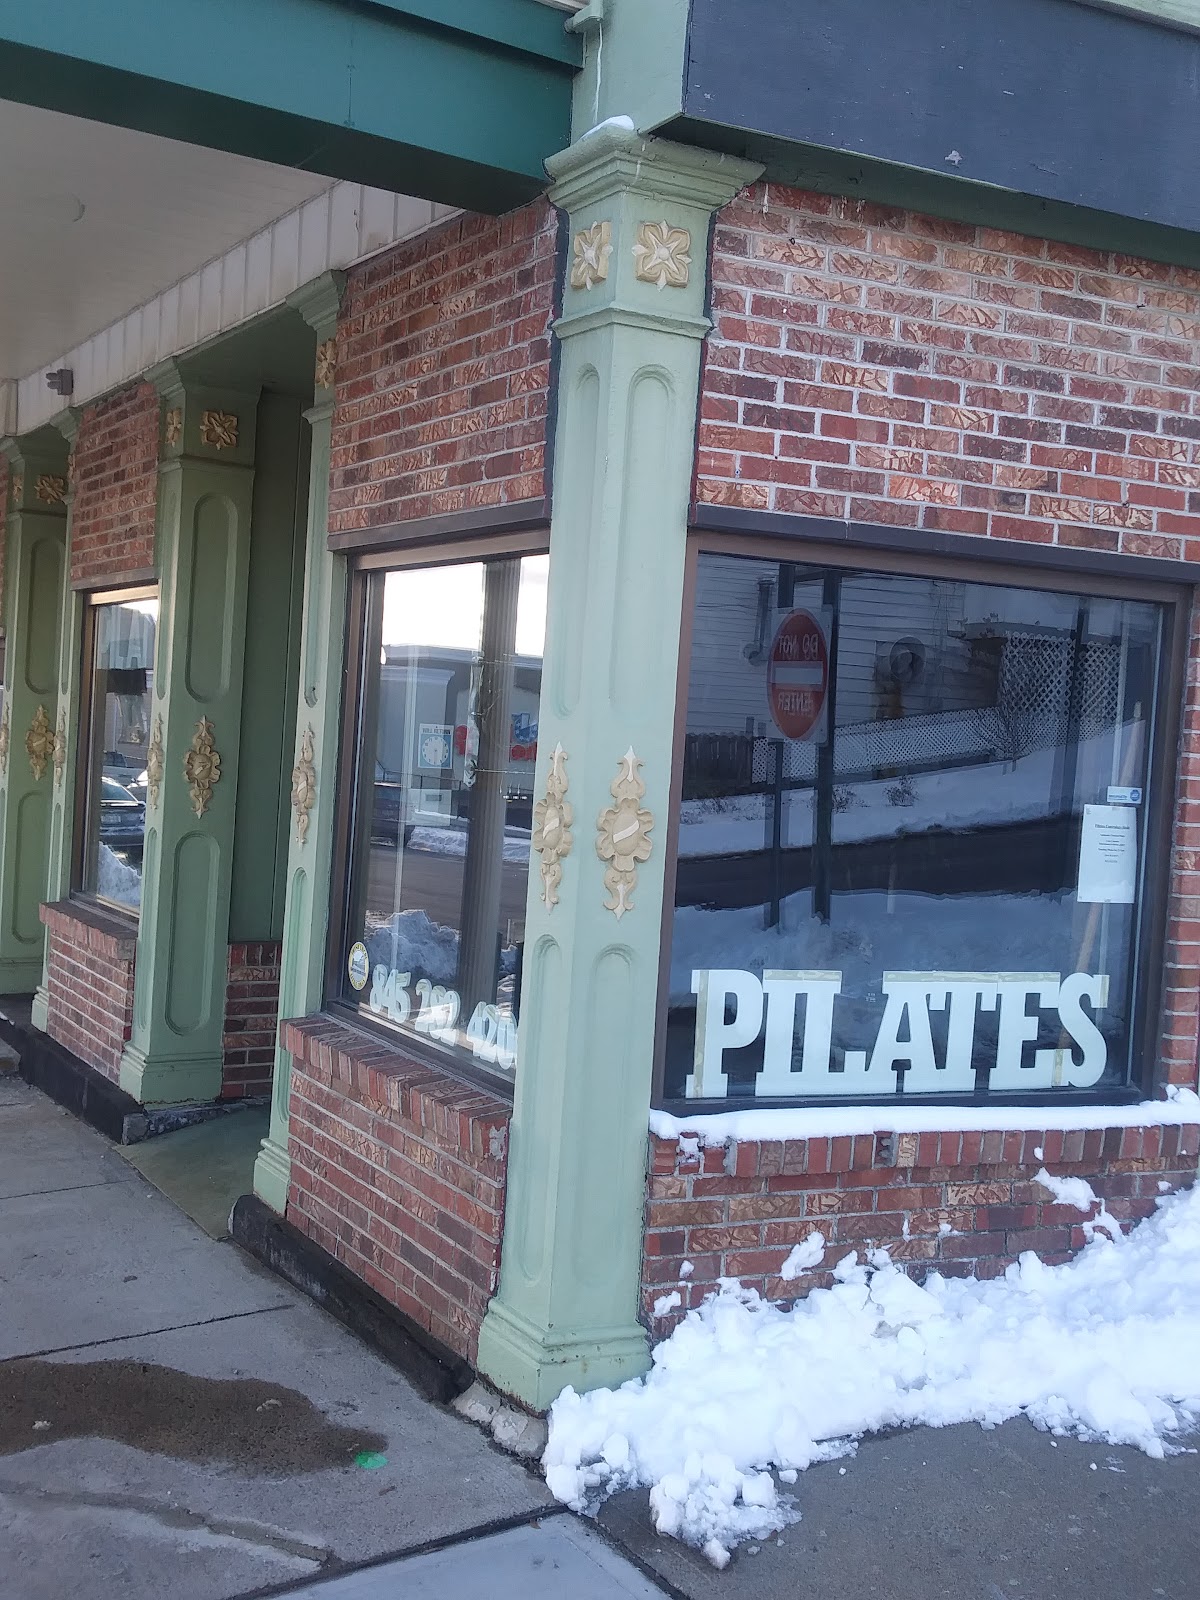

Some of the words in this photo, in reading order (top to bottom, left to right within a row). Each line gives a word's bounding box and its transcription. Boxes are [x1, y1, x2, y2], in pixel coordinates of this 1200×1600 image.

[369, 964, 411, 1024] 845
[466, 1001, 518, 1070] 420
[685, 969, 1110, 1099] PILATES
